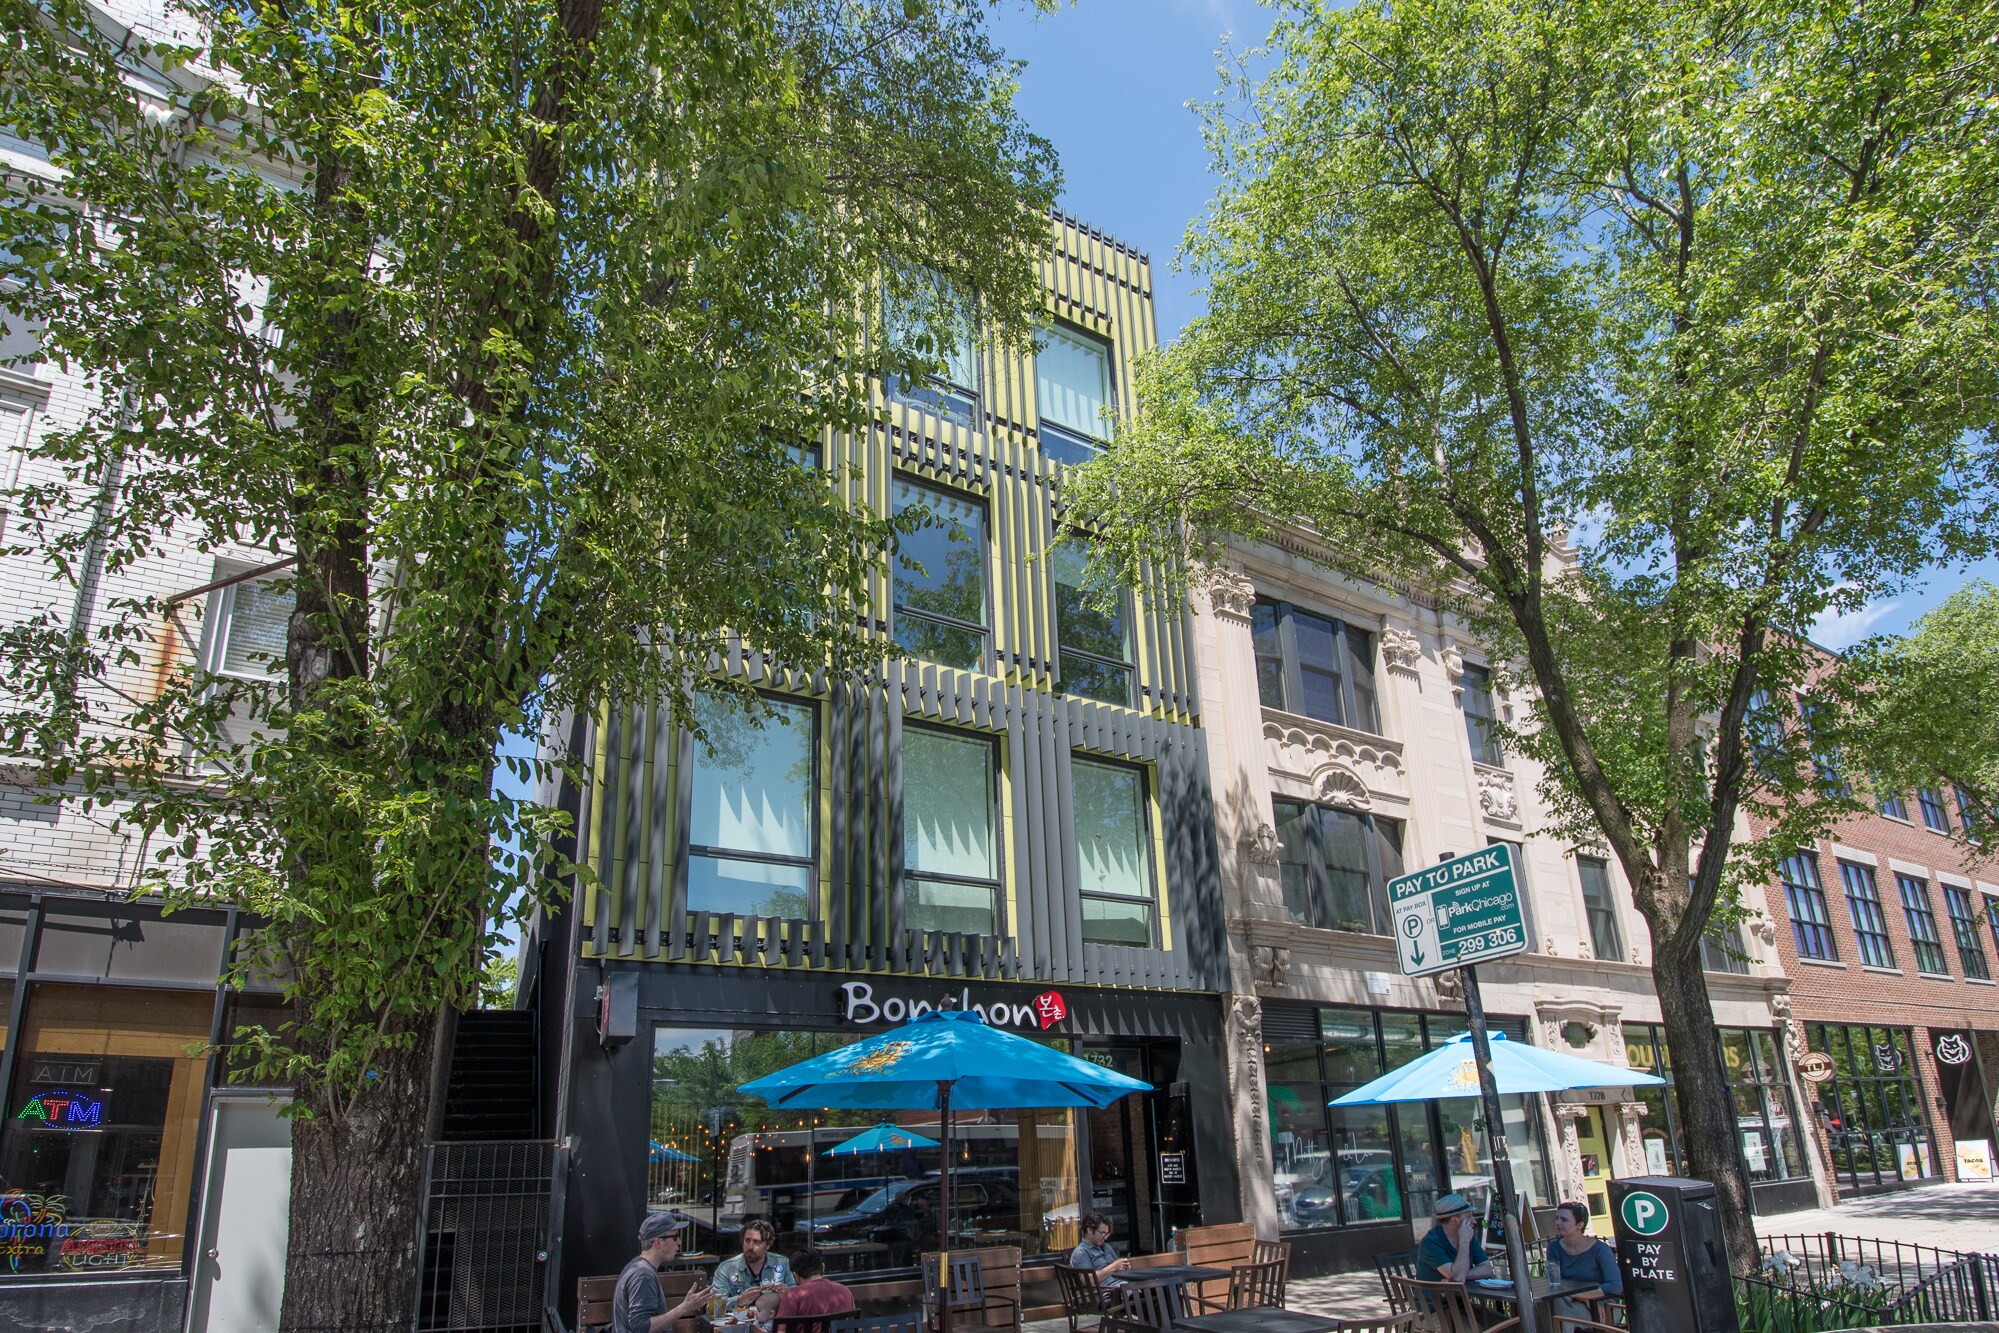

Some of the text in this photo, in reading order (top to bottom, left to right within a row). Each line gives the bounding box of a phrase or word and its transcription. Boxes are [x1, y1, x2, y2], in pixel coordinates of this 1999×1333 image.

[1396, 851, 1500, 898] PAY TO PARK
[1455, 880, 1490, 896] SIGN UP AT
[1414, 901, 1427, 909] BOX
[1448, 892, 1513, 918] ParkChicago
[1407, 918, 1419, 936] P
[1426, 917, 1436, 925] OR
[1453, 914, 1507, 935] FOR MOBILE PAY
[1442, 928, 1517, 956] ZONE 299 306
[1084, 1054, 1114, 1068] 1732
[35, 1065, 94, 1083] ATM
[17, 1099, 101, 1122] ATM
[1634, 1199, 1655, 1229] P
[1637, 1243, 1662, 1255] PAY
[72, 1253, 131, 1266] LIGHT
[1641, 1256, 1659, 1267] BY
[1632, 1267, 1675, 1280] PLATE
